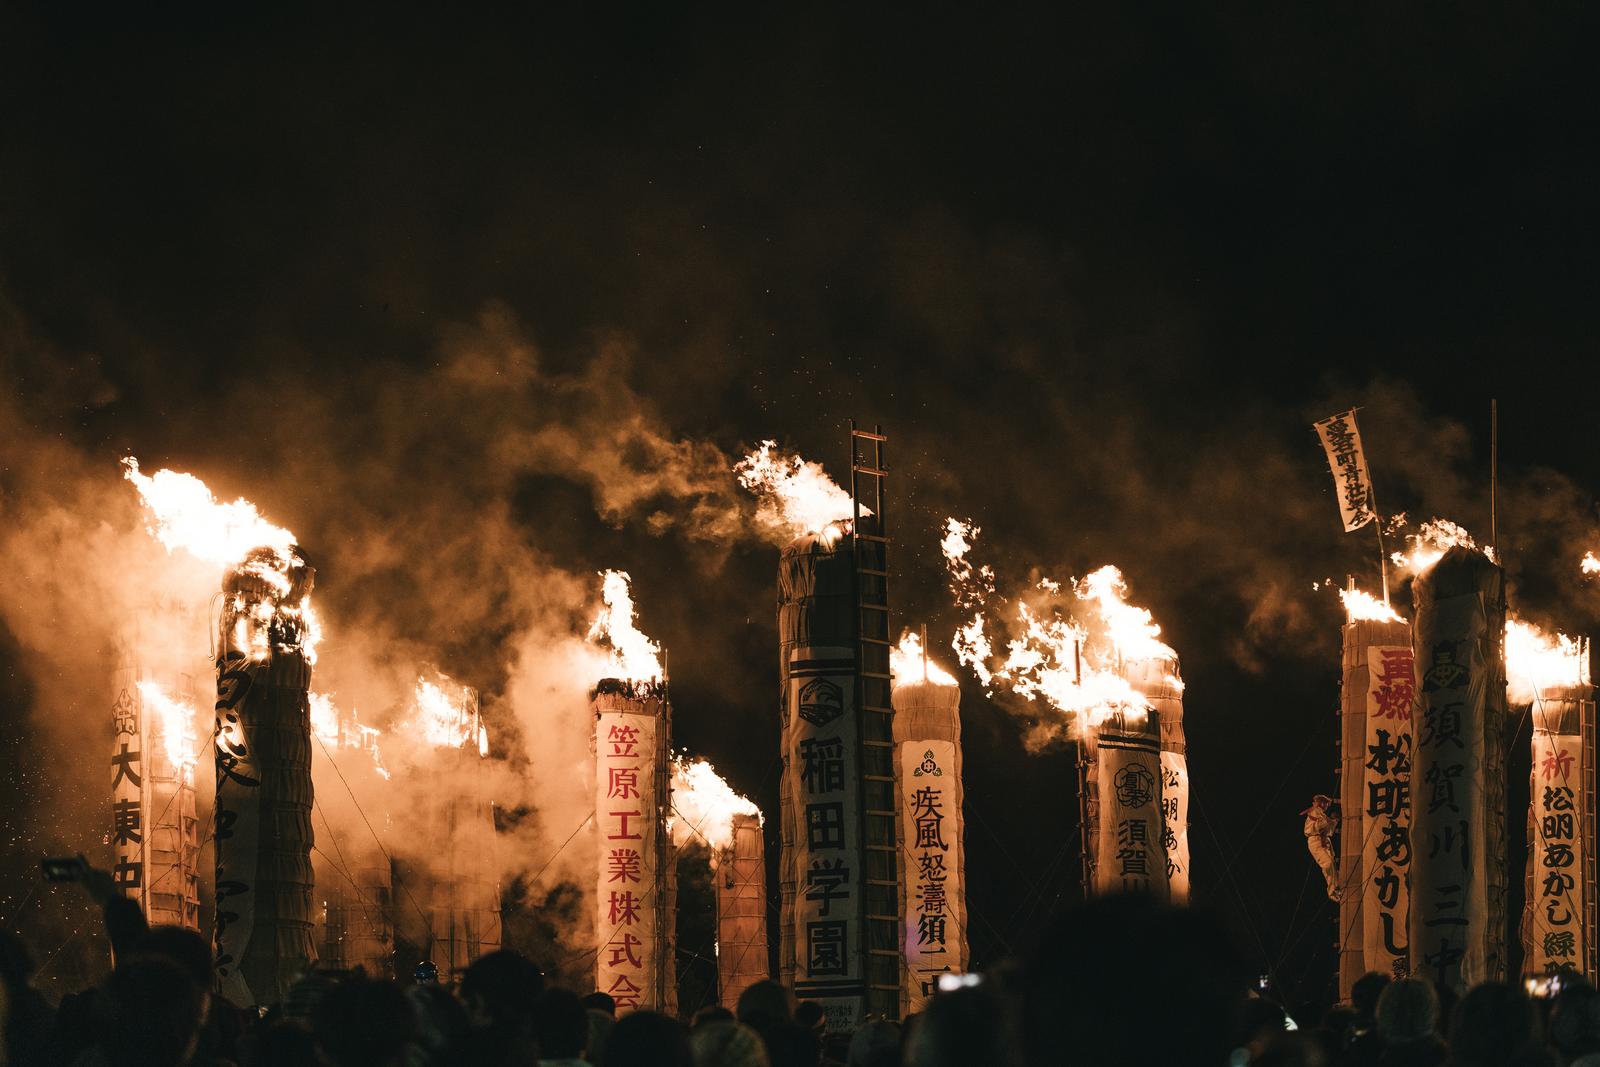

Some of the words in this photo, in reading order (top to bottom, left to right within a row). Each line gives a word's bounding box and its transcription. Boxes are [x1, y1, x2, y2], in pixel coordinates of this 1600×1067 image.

[112, 743, 141, 897] 大東中
[607, 725, 642, 1009] 笠原工業株式会
[800, 737, 849, 977] 稲田学園
[1420, 702, 1469, 990] 須賀川三中
